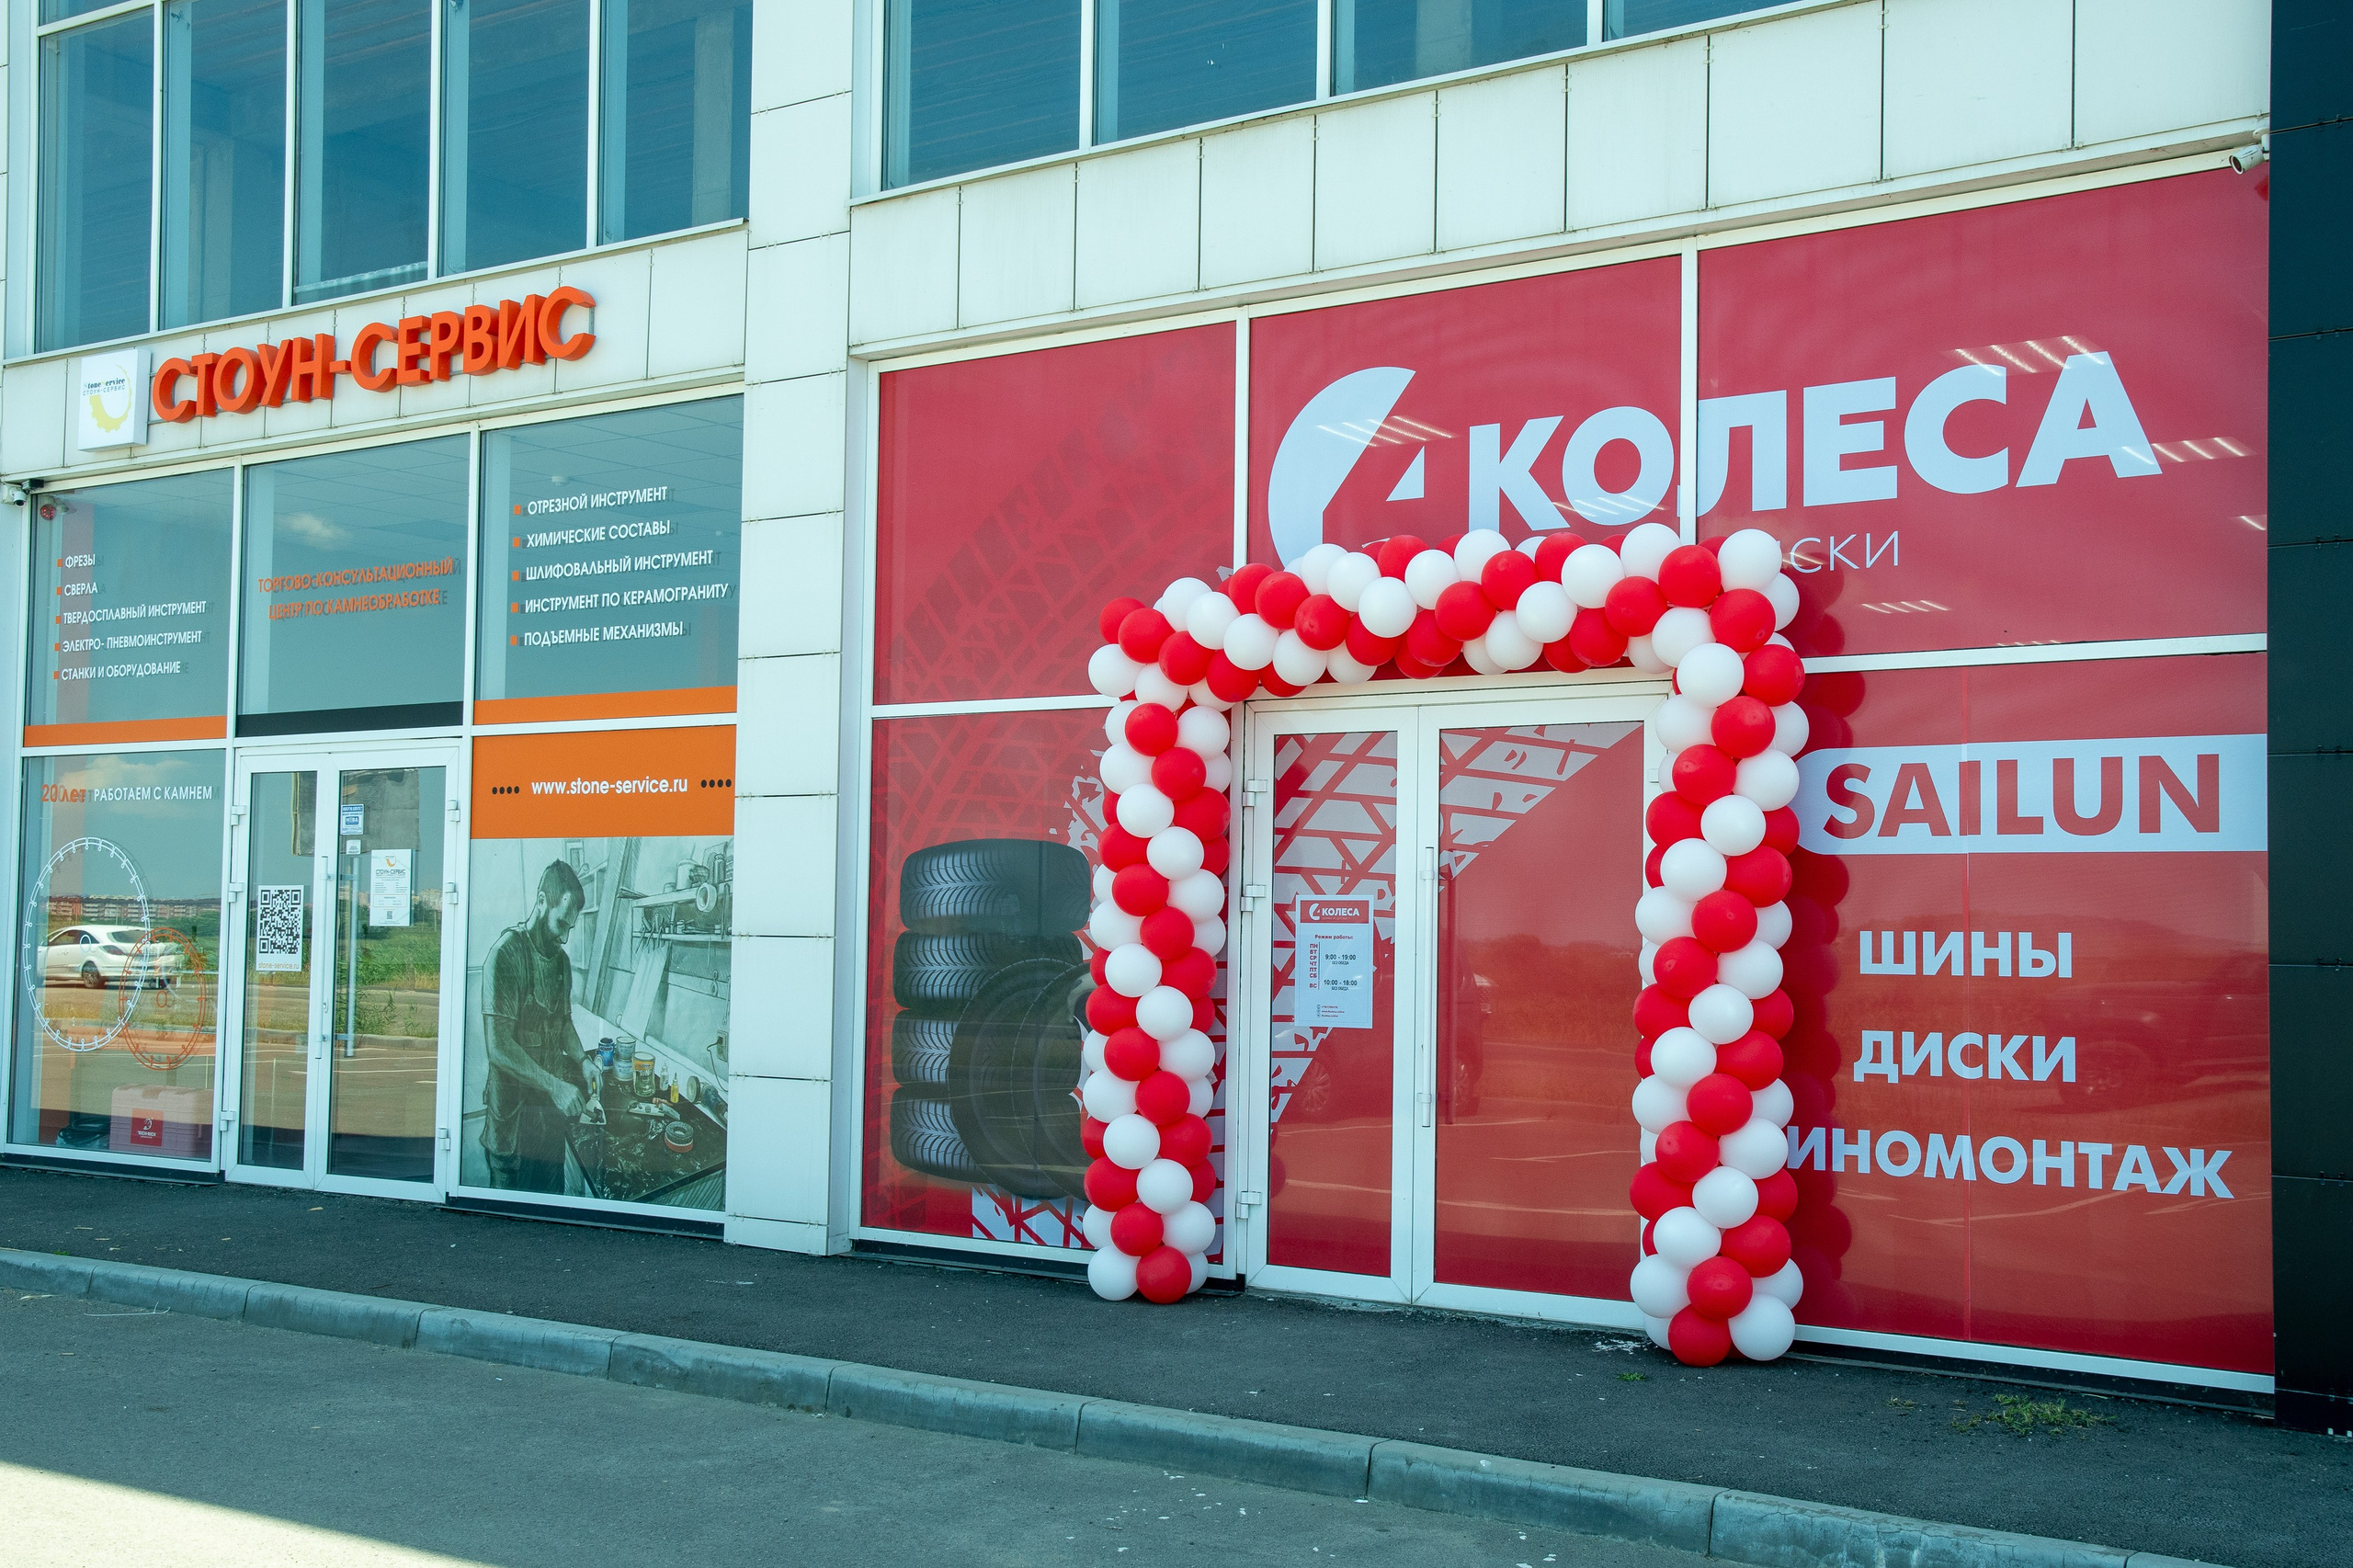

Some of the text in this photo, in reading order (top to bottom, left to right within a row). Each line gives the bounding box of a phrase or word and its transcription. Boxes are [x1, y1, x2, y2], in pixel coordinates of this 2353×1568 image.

[152, 286, 597, 424] СТОУН-СЕРВИС
[83, 385, 126, 395] СТОУН-СЕРВИС
[1469, 351, 2163, 533] КОЛЕСА
[527, 486, 667, 515] ОТРЕЗНОЙ ИНСТРУМЕНТ
[526, 520, 671, 548] ХИМИЧЕСКИЕ СОСТАВЫ
[65, 553, 96, 568] ФРЕЗЫ
[526, 550, 713, 581] ШЛИФОВАЛЬНЫЙ ИНСТРУМЕНТ
[1777, 530, 1899, 574] СКИ
[258, 556, 453, 593] ТОРГОВО-КОНСУЛЬТАЦИОННЫЙ
[64, 582, 98, 597] СВЕРЛА
[525, 583, 729, 613] ИНСТРУМЕНТ ПО КЕРАМОГРАНИТУ
[63, 600, 207, 625] ТВЕРДОСПЛАВНЫЙ ИНСТРУМЕНТ
[268, 588, 440, 621] ЦЕНТР ПО КАМНЕОБРАБОТКЕ
[63, 631, 202, 653] ЭЛЕКТРО- ПНЕВМОИНСТРУМЕНТ
[524, 621, 684, 648] ПОДЪЕМНЫЕ МЕХАНИЗМЫ
[61, 661, 181, 680] СТАНКИ И ОБОРУДОВАНИЕ
[94, 787, 151, 801] РАБОТАЕМ
[153, 786, 162, 800] С
[164, 786, 212, 801] КАМНЕМ
[531, 775, 688, 795] www.stone-service.ru
[1823, 754, 2220, 840] SAILUN
[1322, 908, 1359, 916] КОЛЕСА
[1859, 930, 2073, 978] ШИНЫ
[1853, 1029, 2076, 1084] ДИСКИ
[1787, 1126, 2234, 1199] ИНОМОНТАЖ
